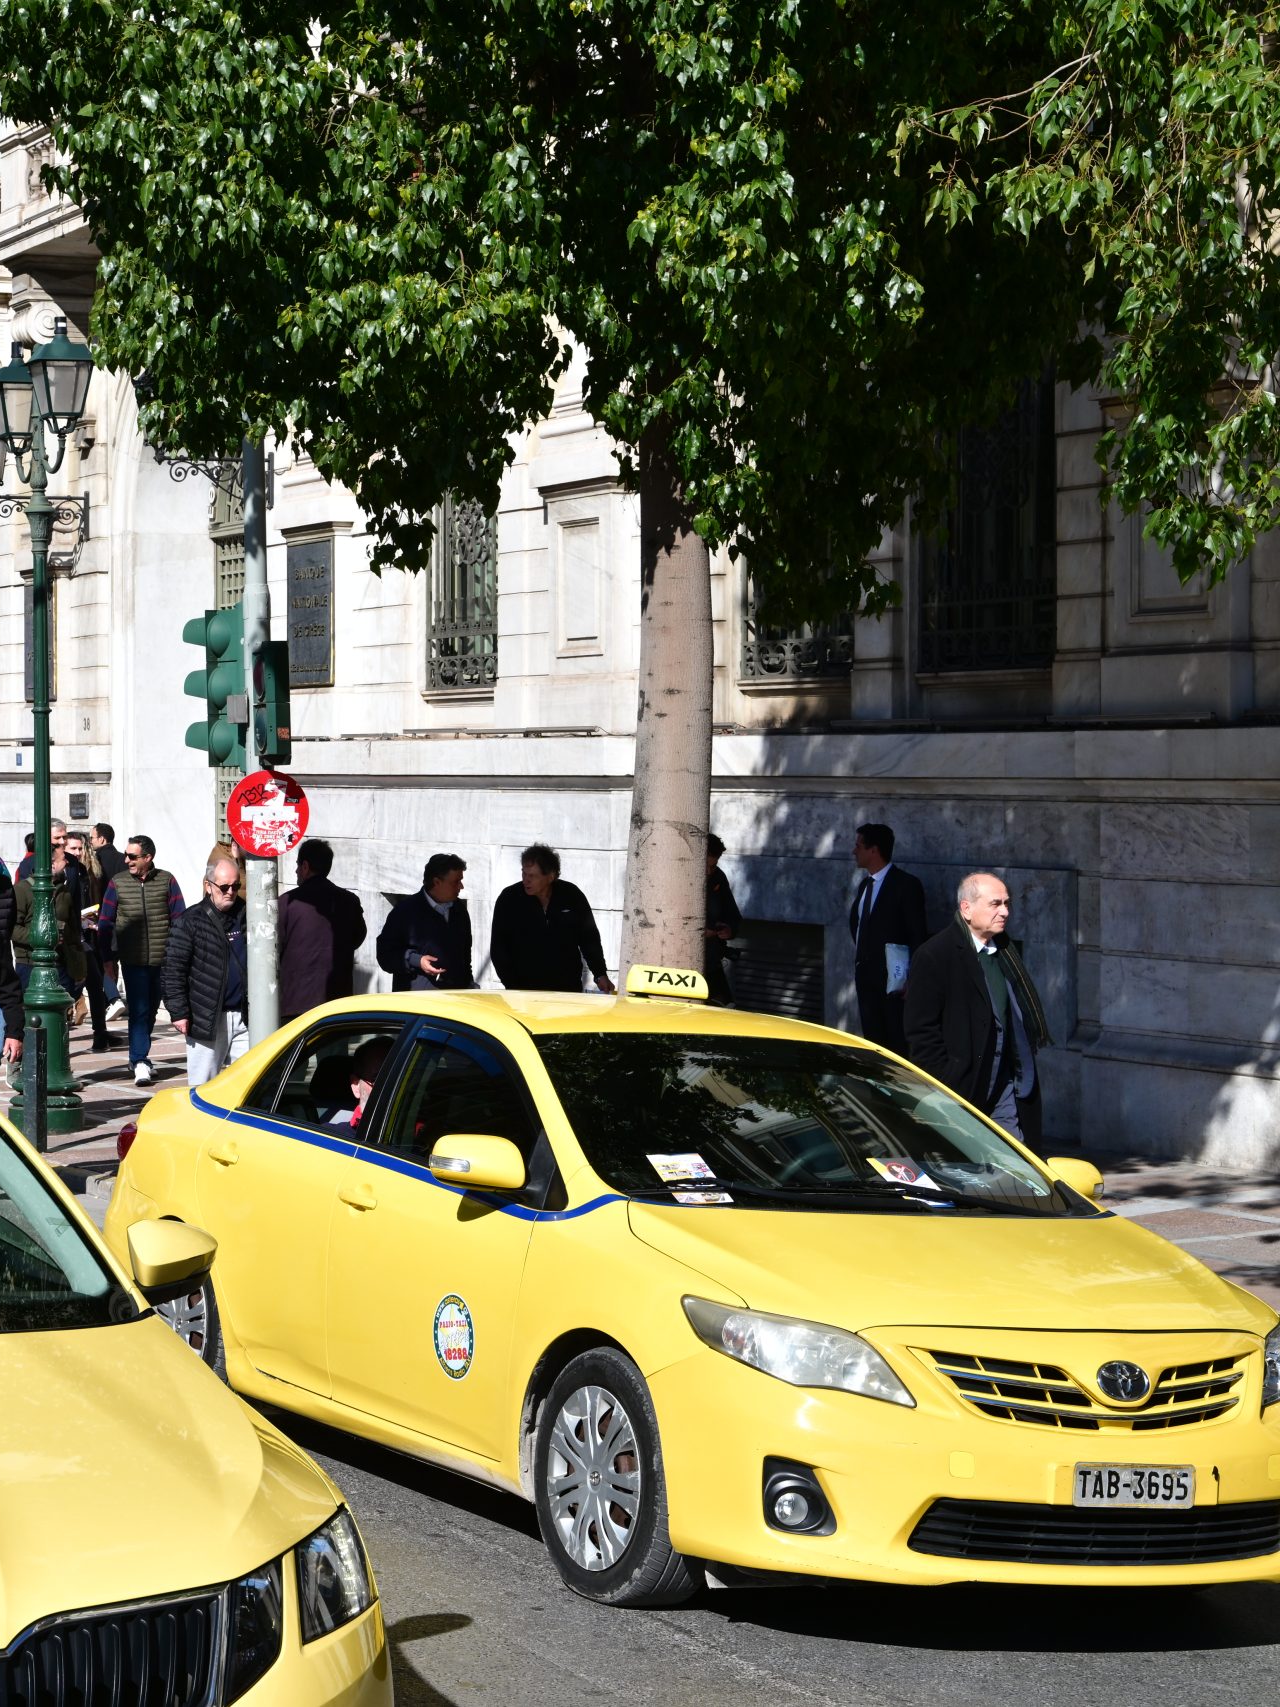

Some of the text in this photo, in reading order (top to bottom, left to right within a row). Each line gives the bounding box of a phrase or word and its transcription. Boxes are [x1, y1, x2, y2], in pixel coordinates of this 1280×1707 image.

[295, 565, 325, 580] BANQUE
[83, 717, 91, 731] 38
[643, 970, 696, 988] TAXI
[444, 1347, 468, 1360] 18288
[1078, 1470, 1189, 1501] TAB-3695
